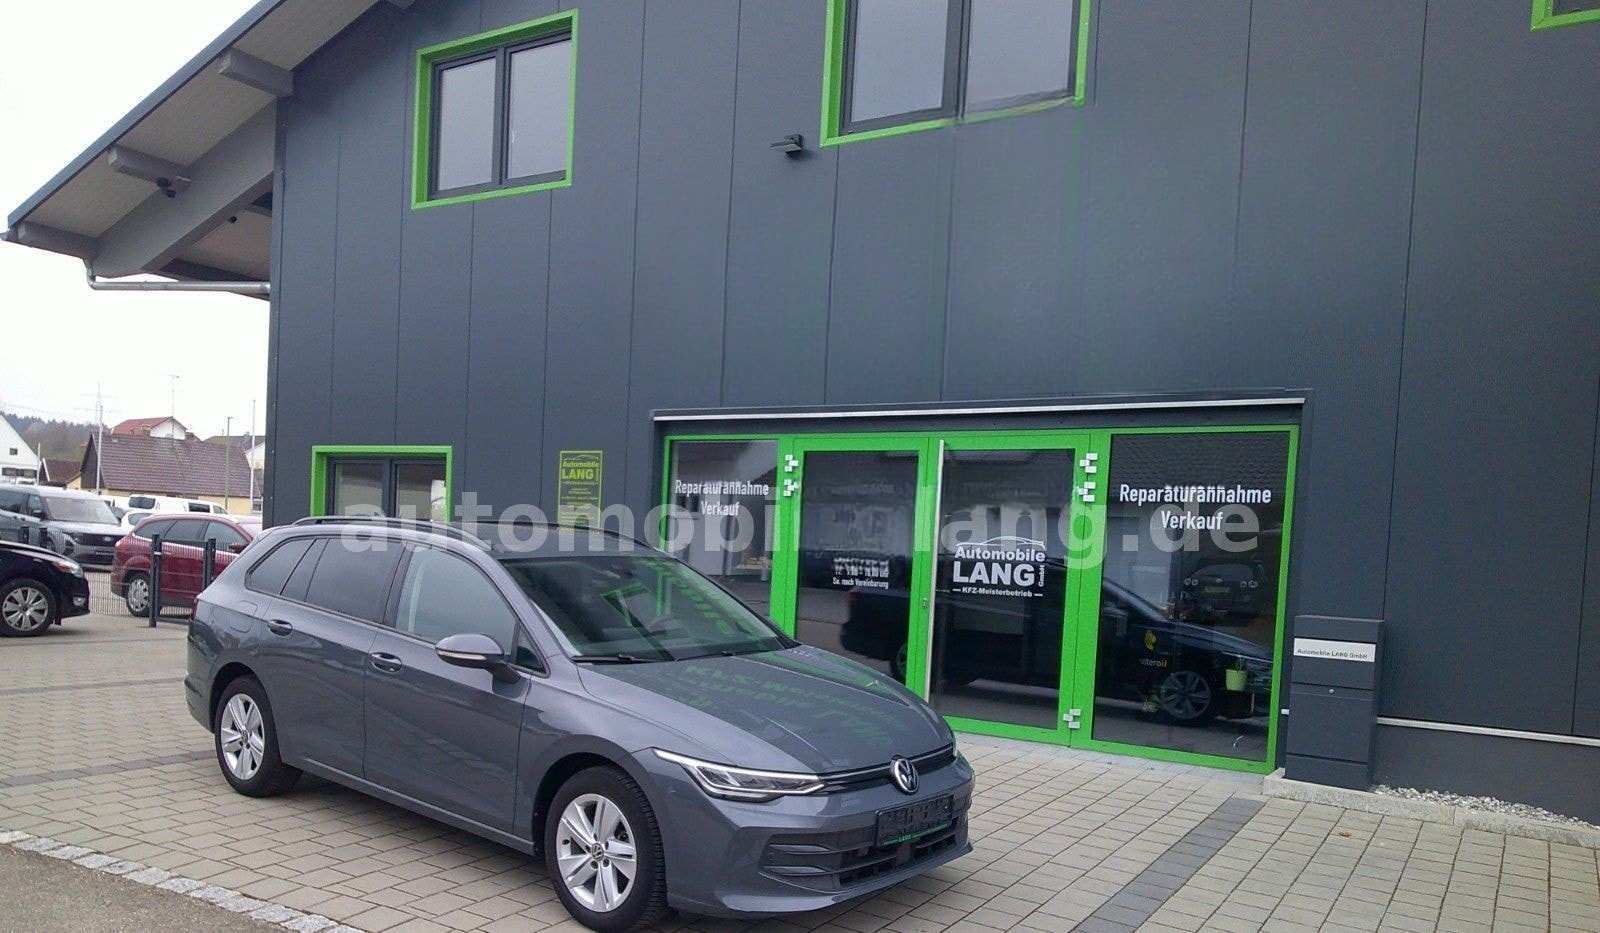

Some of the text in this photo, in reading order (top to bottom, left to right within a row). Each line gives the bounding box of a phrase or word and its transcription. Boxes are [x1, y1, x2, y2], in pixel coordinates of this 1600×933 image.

[561, 469, 594, 480] LANG
[675, 480, 770, 497] Reparaturannahme
[1119, 483, 1272, 506] Reparaturannahme
[701, 501, 740, 516] Verkauf
[1161, 510, 1224, 531] Verkauf
[954, 546, 1046, 562] Automobile
[953, 561, 1035, 587] LANG
[962, 586, 1033, 598] KFZ-Meisterbetrieb
